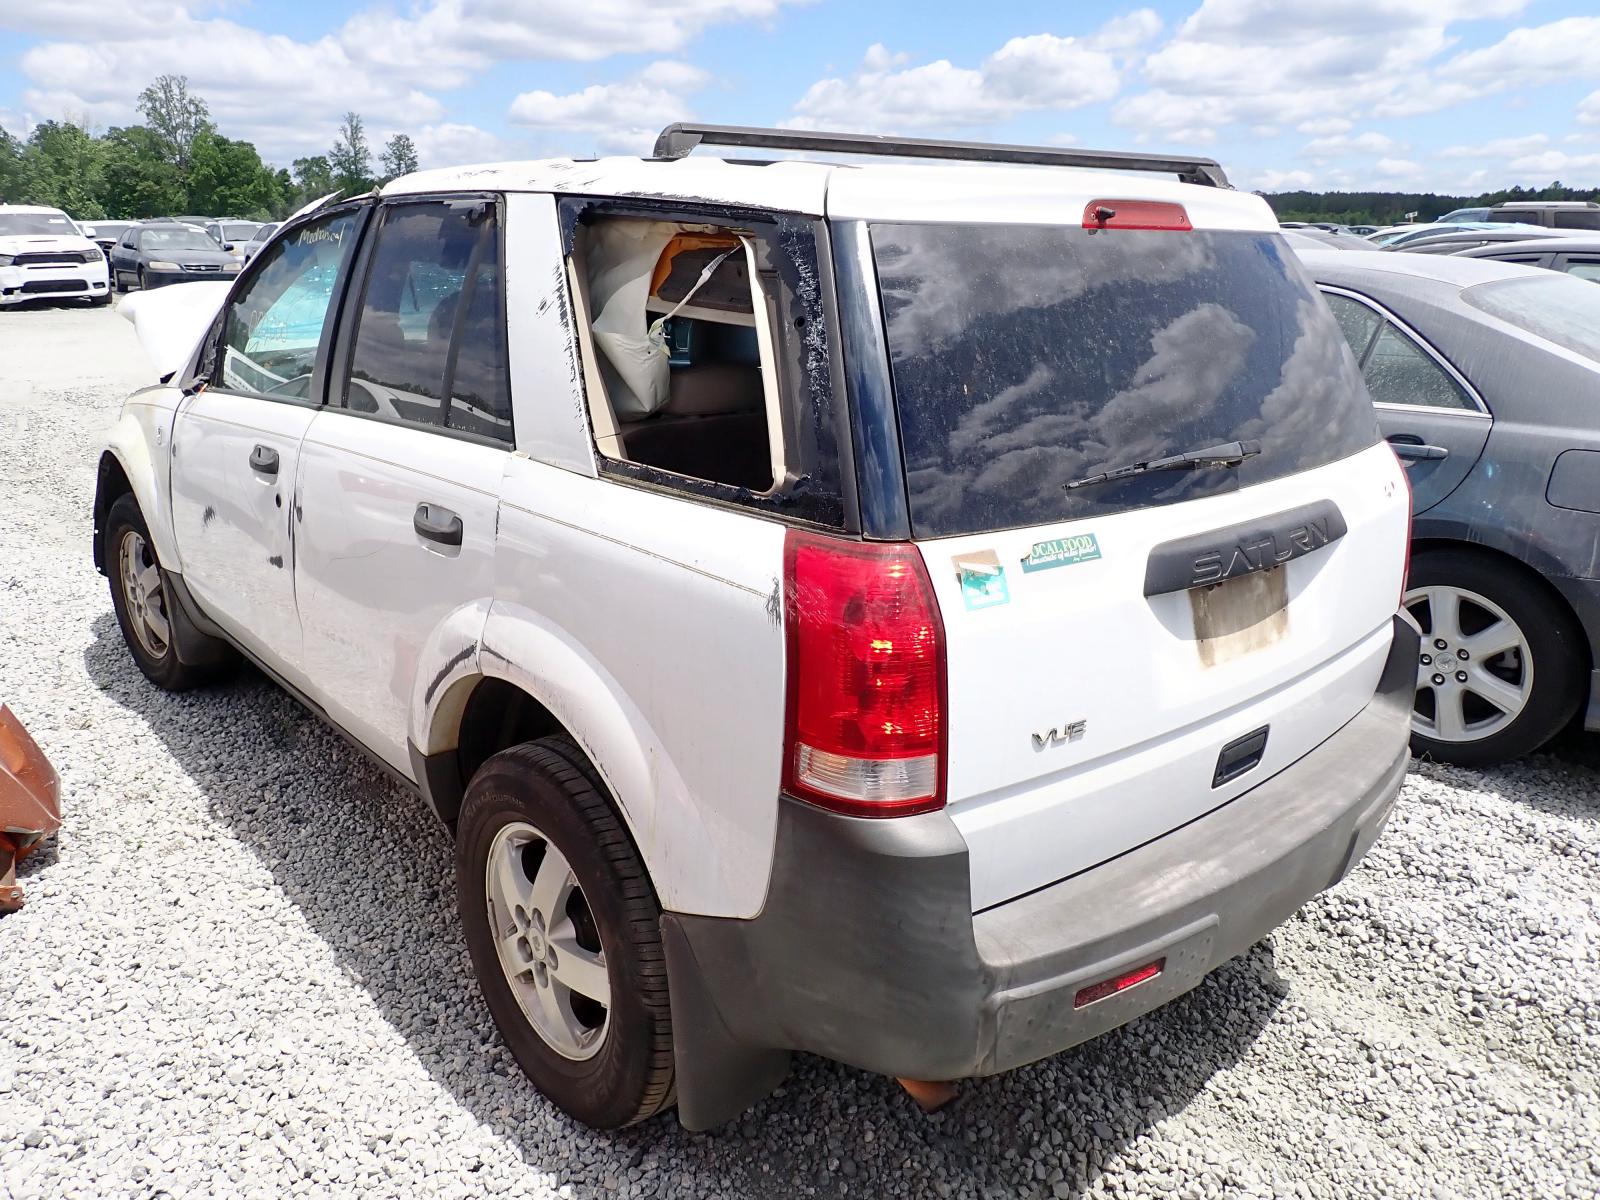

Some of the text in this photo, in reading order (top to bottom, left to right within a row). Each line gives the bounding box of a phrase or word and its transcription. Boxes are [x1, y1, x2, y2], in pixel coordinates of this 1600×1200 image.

[1031, 535, 1093, 558] OCAL FOOD
[1191, 517, 1330, 584] SATURN
[1031, 719, 1087, 749] VUE
